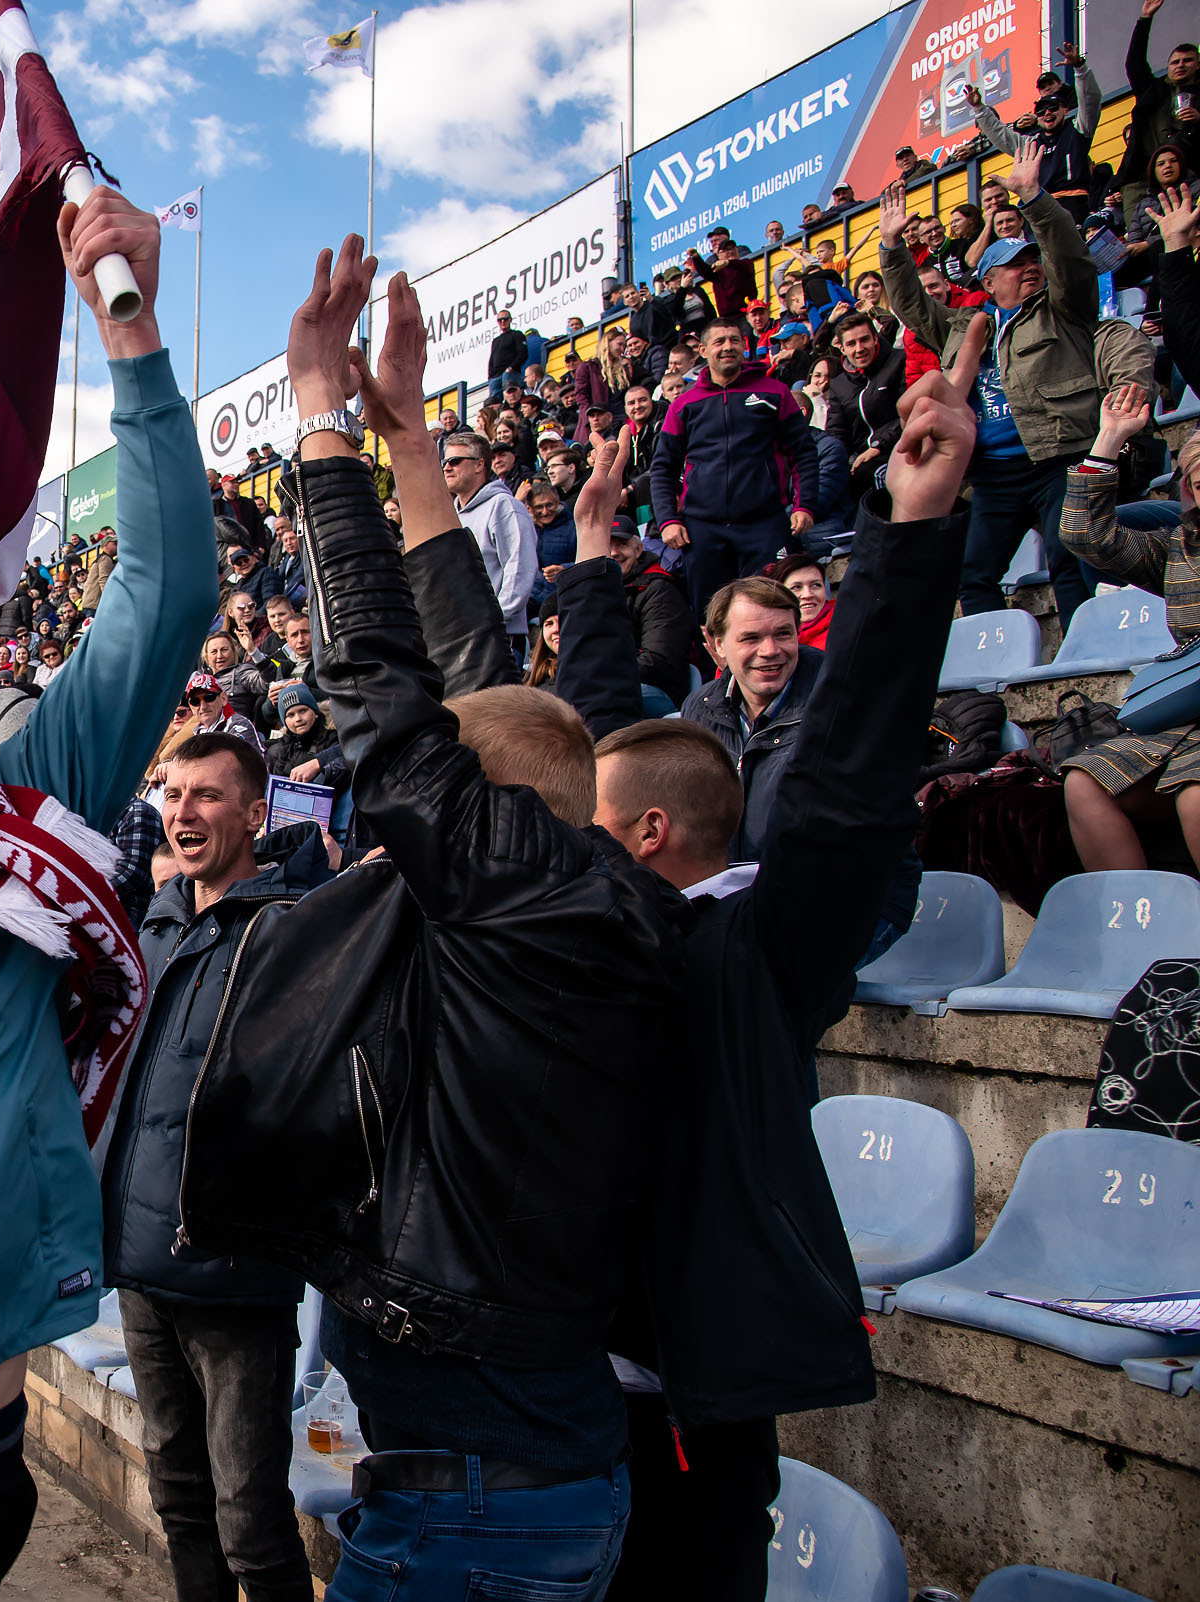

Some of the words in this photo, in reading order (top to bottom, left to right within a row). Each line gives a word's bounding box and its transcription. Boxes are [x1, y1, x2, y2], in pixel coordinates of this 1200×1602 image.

[911, 32, 980, 82] MOTOR
[983, 15, 1017, 44] OIL
[925, 0, 1016, 53] ORIGINAL
[694, 77, 850, 184] STOKKER
[650, 218, 697, 252] STACIJAS
[698, 205, 722, 230] IELA
[723, 190, 750, 218] 129d,
[751, 154, 824, 203] DAUGAVPILS
[426, 285, 498, 344] AMBER
[504, 228, 604, 310] STUDIOS
[437, 282, 588, 364] WWW.AMBESTUDIOS.COM
[245, 375, 294, 428] OPTI
[977, 627, 1005, 650] 25
[1117, 605, 1150, 630] 26
[1101, 1169, 1157, 1206] 29
